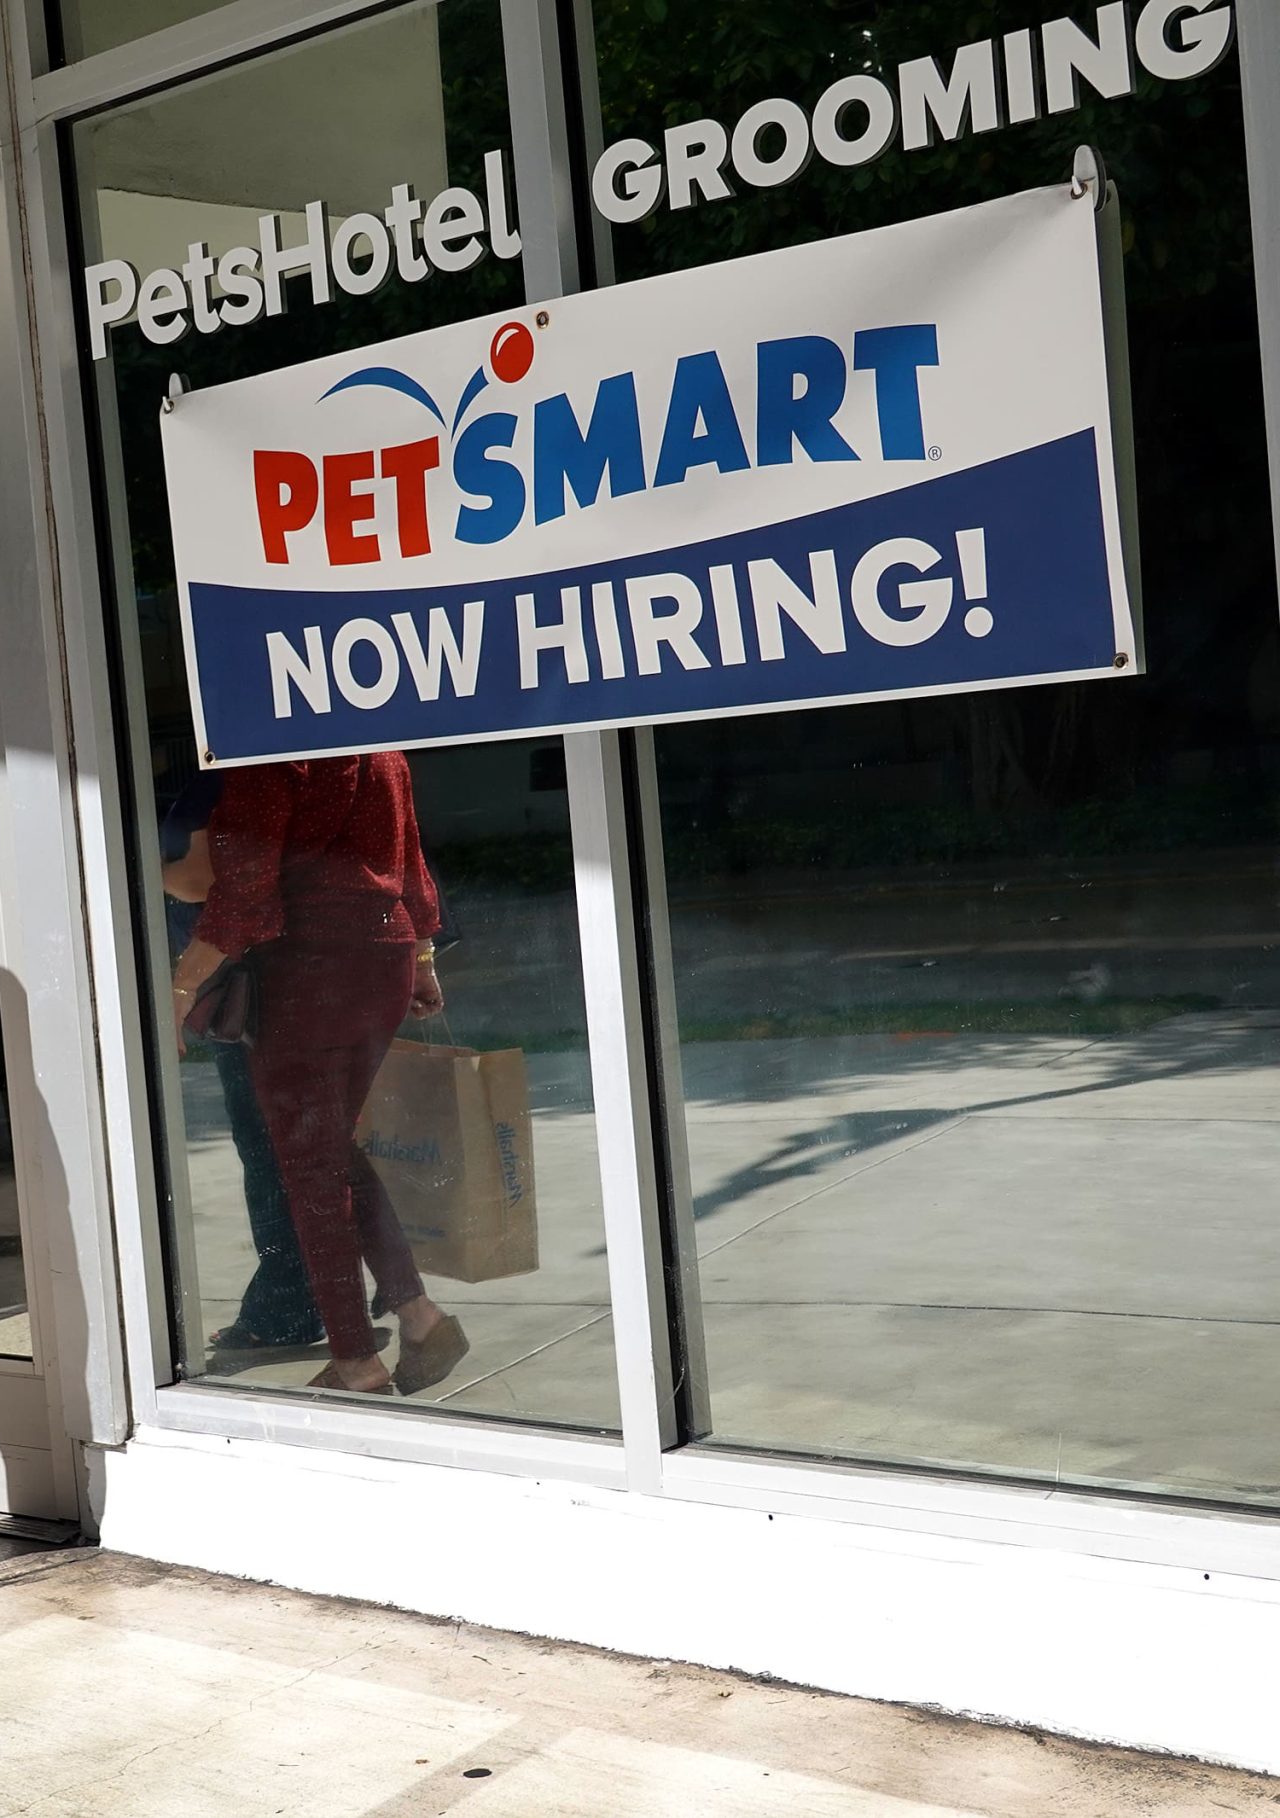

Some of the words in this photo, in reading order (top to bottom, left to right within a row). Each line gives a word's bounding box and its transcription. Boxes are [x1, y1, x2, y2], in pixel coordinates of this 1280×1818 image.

[592, 0, 1232, 223] GROOMING
[85, 149, 523, 361] PetsHotel
[266, 601, 485, 719] NOW
[516, 527, 994, 690] HIRING!
